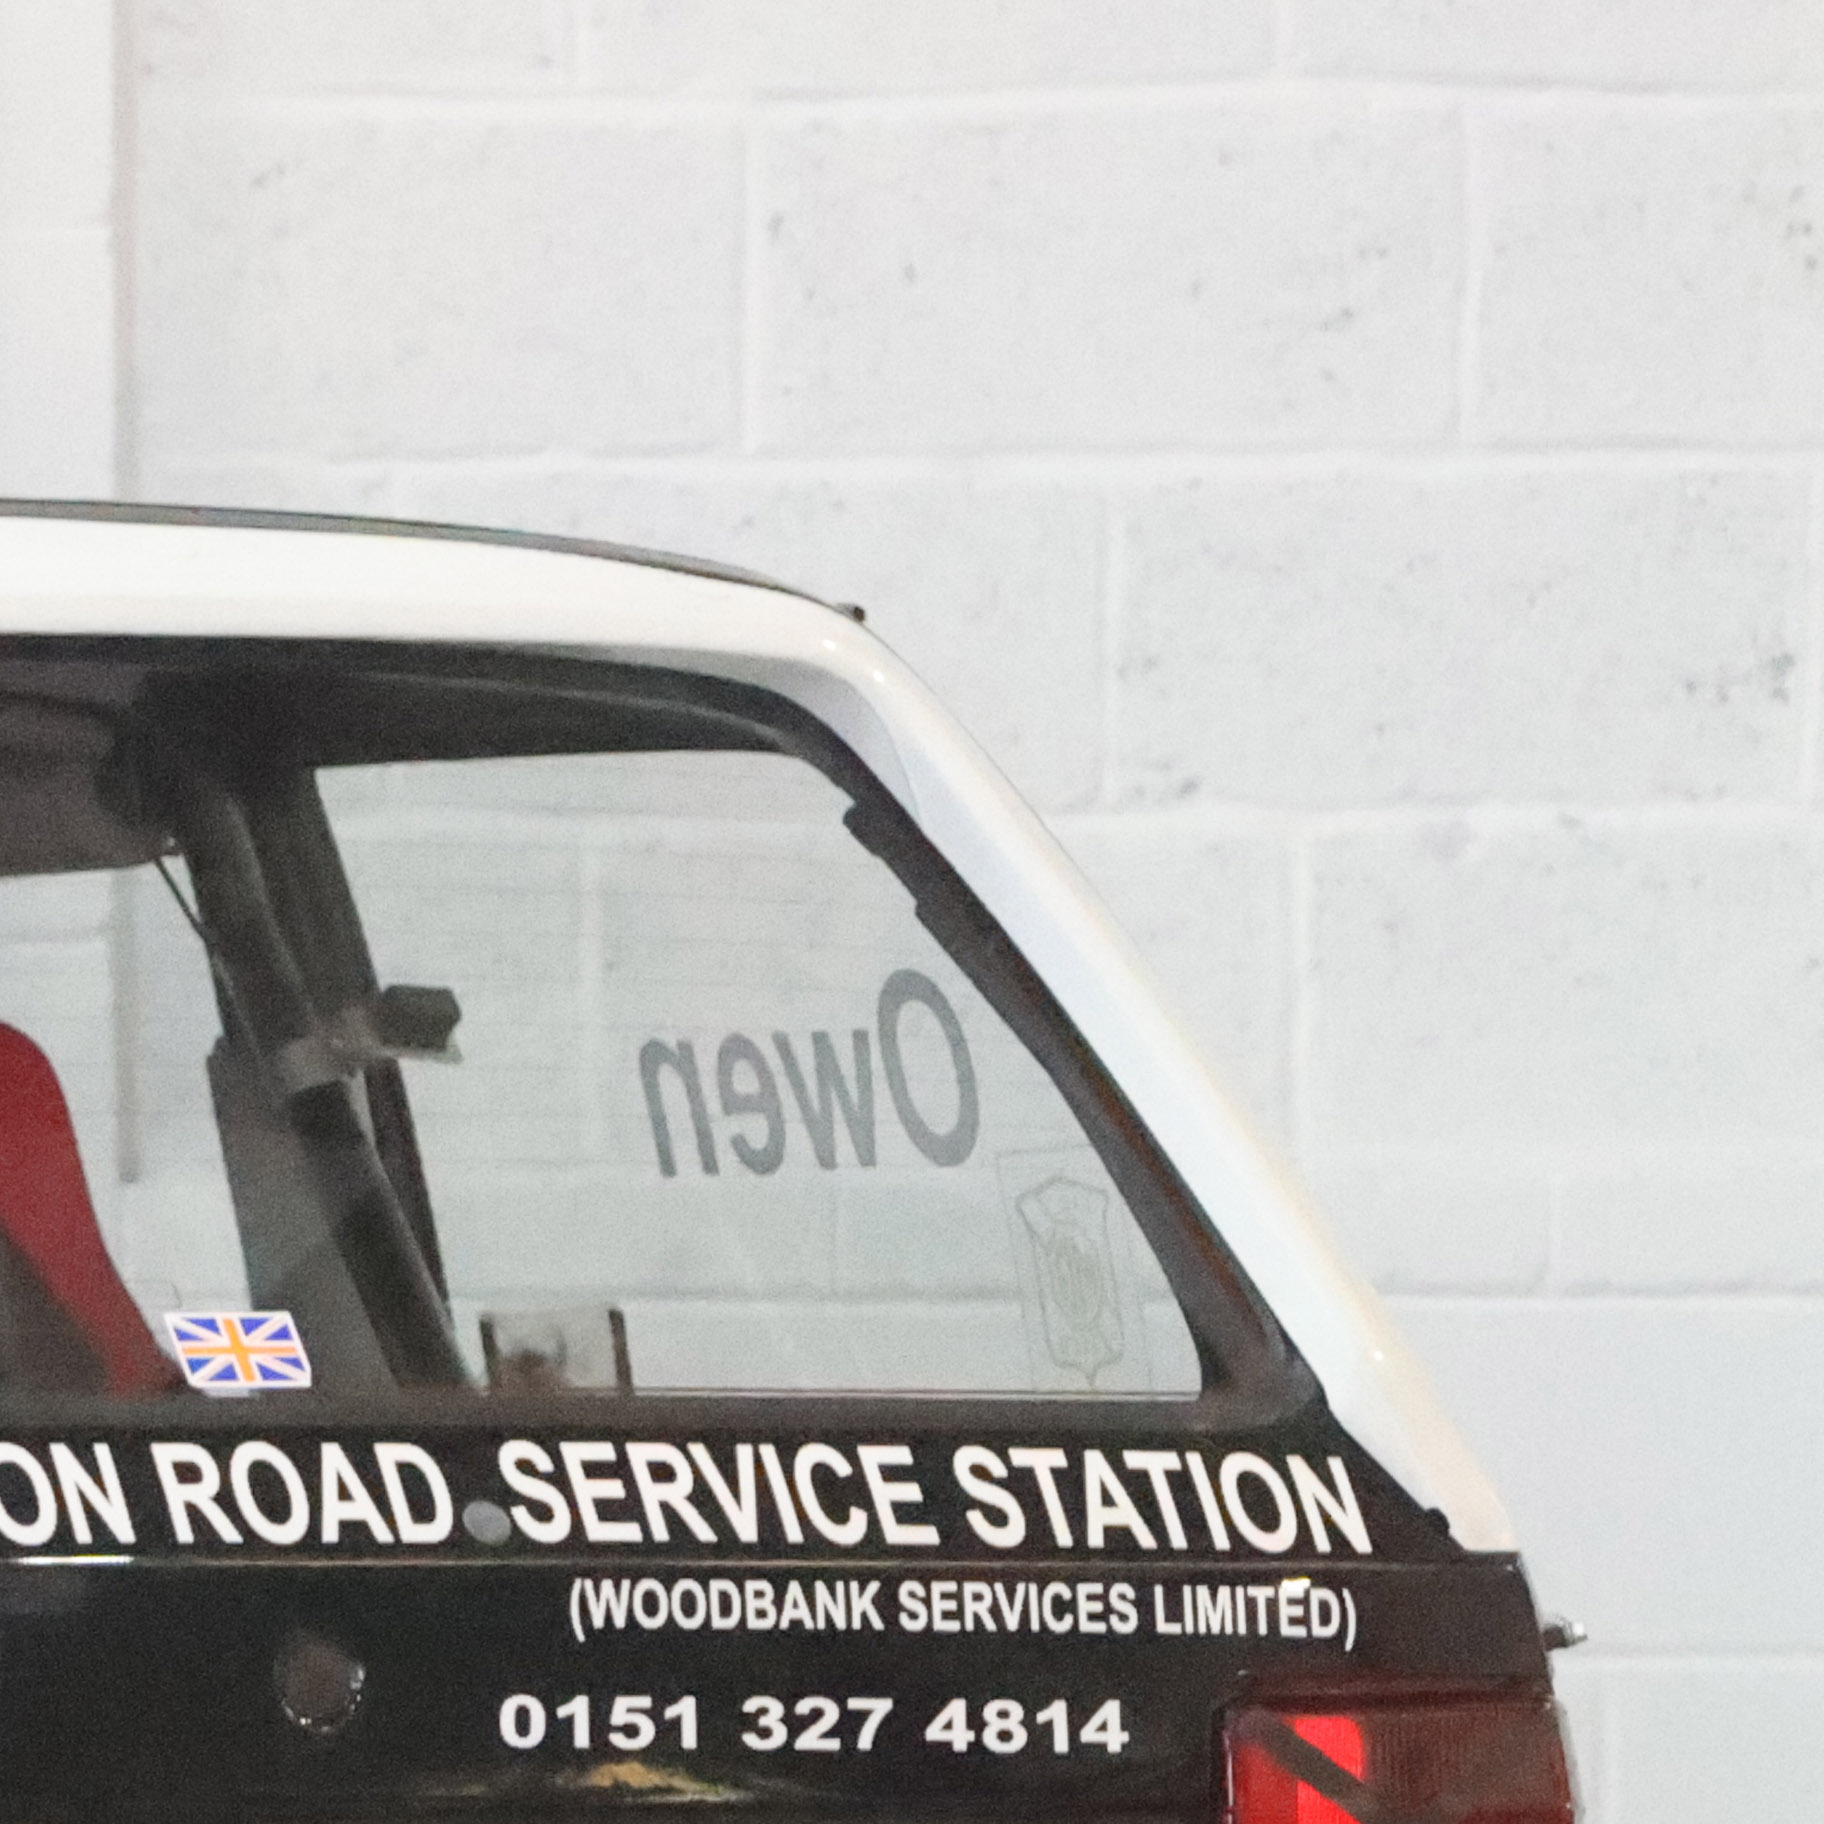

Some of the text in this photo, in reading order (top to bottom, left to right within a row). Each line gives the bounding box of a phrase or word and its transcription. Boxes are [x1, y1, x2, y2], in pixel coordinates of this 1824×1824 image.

[150, 1441, 454, 1546] ROAD
[499, 1440, 940, 1547] SERVICE
[952, 1445, 1374, 1555] STATION
[569, 1577, 1357, 1652] (WOODBANK SERVICES LIMITED)
[498, 1693, 1130, 1754] 0151 327 4814
